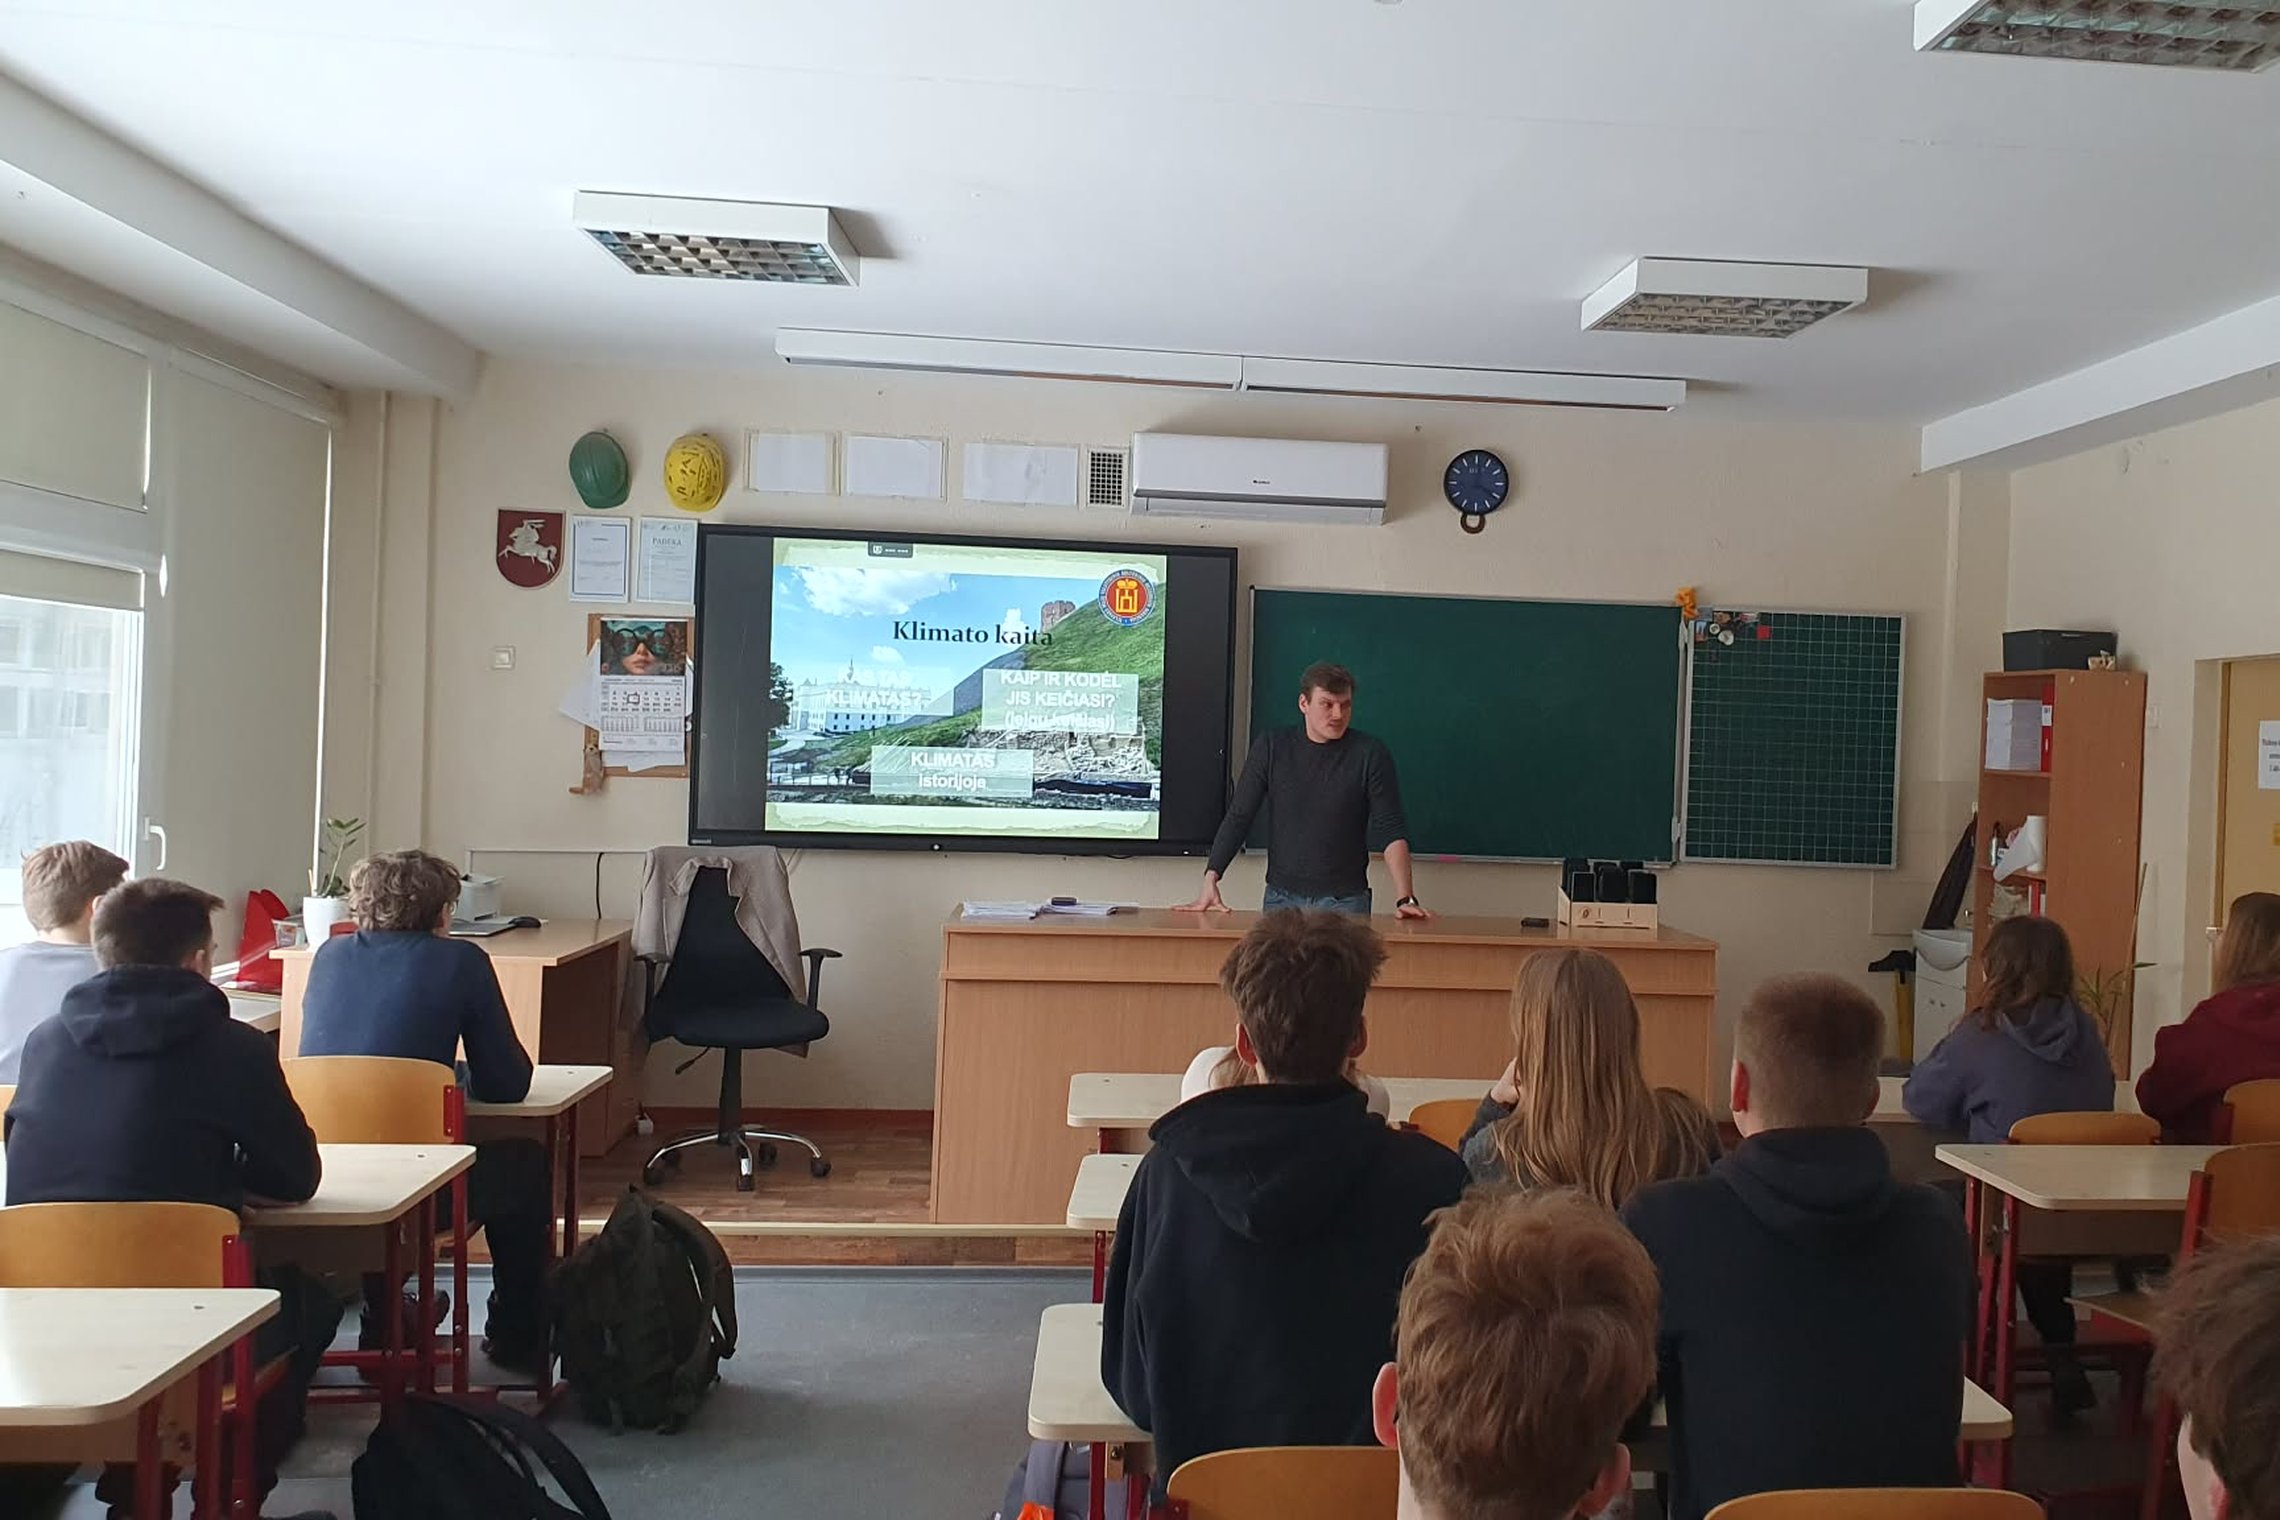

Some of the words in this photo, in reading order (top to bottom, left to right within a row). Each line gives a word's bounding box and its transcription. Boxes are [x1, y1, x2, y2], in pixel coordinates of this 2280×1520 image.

[893, 621, 989, 643] Klimato
[995, 624, 1053, 645] kaita
[1001, 671, 1043, 685] KAIP
[1045, 672, 1060, 687] IR
[826, 690, 922, 707] KLIMATAS?
[1006, 690, 1031, 706] JIS
[1035, 689, 1116, 708] KEIČIASI?
[911, 751, 996, 769] KLIMATAS
